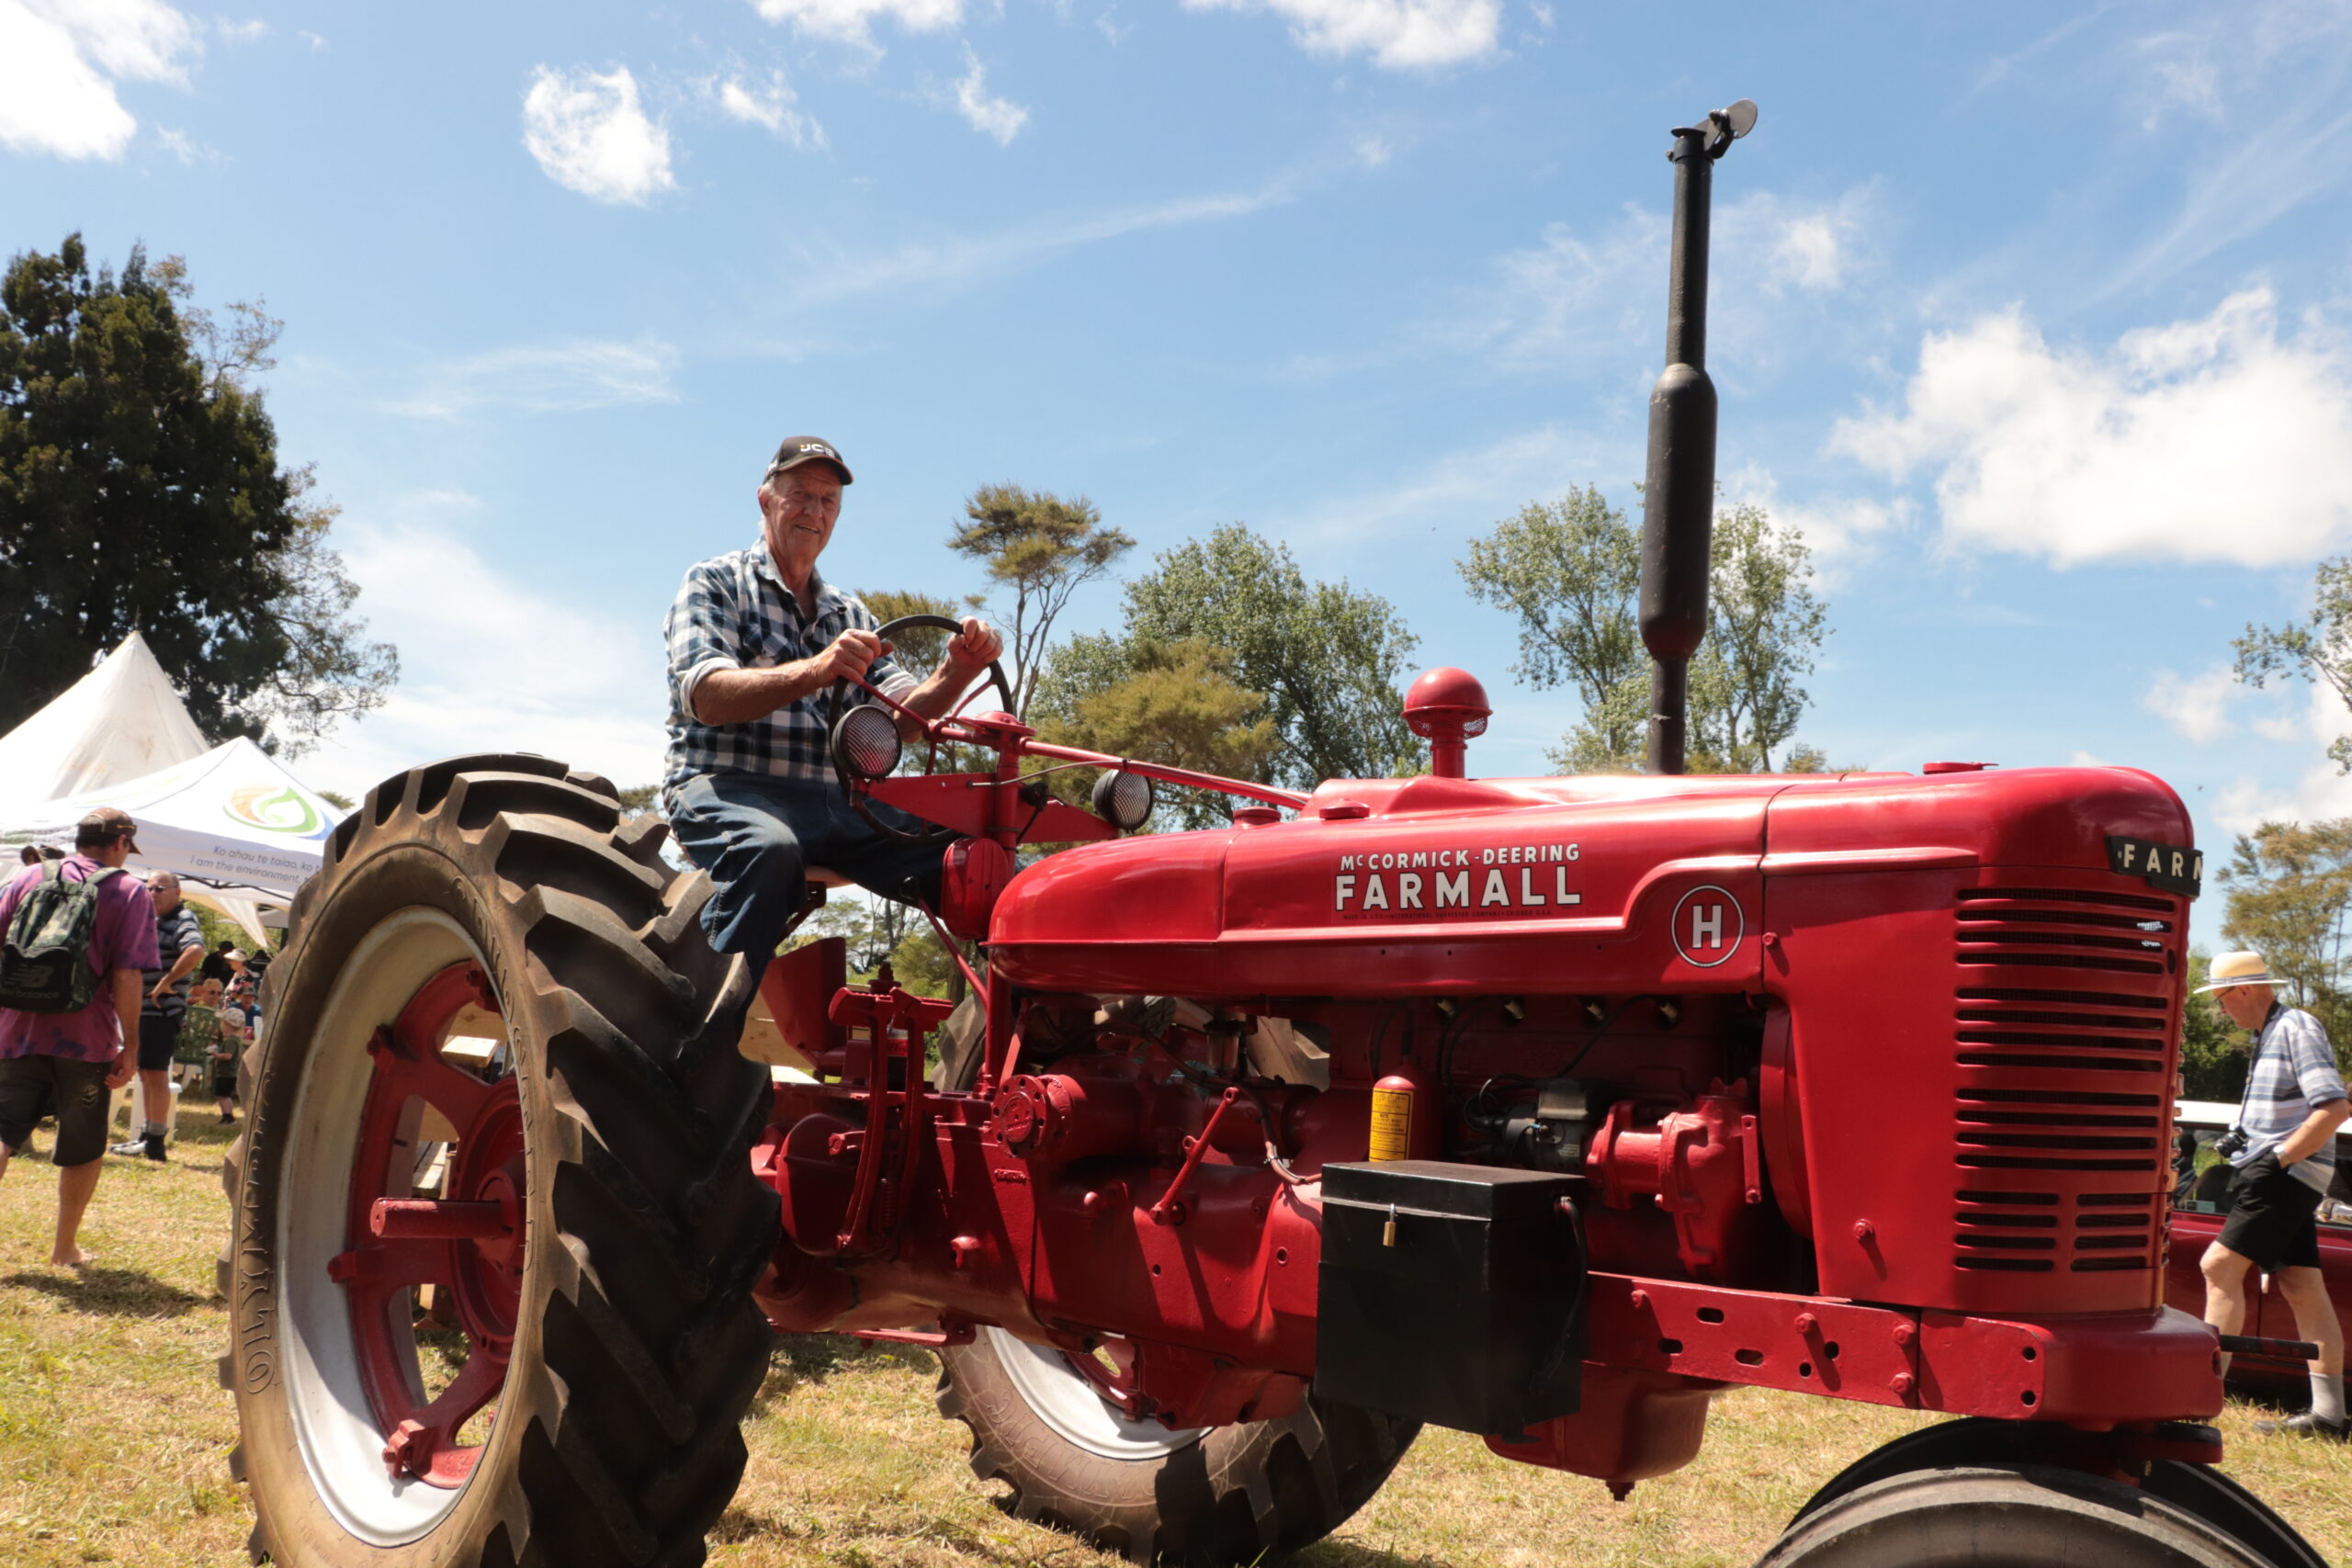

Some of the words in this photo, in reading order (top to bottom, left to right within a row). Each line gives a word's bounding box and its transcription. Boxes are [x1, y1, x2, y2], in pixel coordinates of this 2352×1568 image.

[196, 858, 213, 867] am
[215, 859, 232, 872] the
[213, 845, 226, 856] Ko
[228, 849, 254, 862] ahau
[256, 853, 267, 864] te
[301, 860, 313, 872] ko
[1335, 865, 1582, 910] FARMALL
[1691, 904, 1723, 949] H
